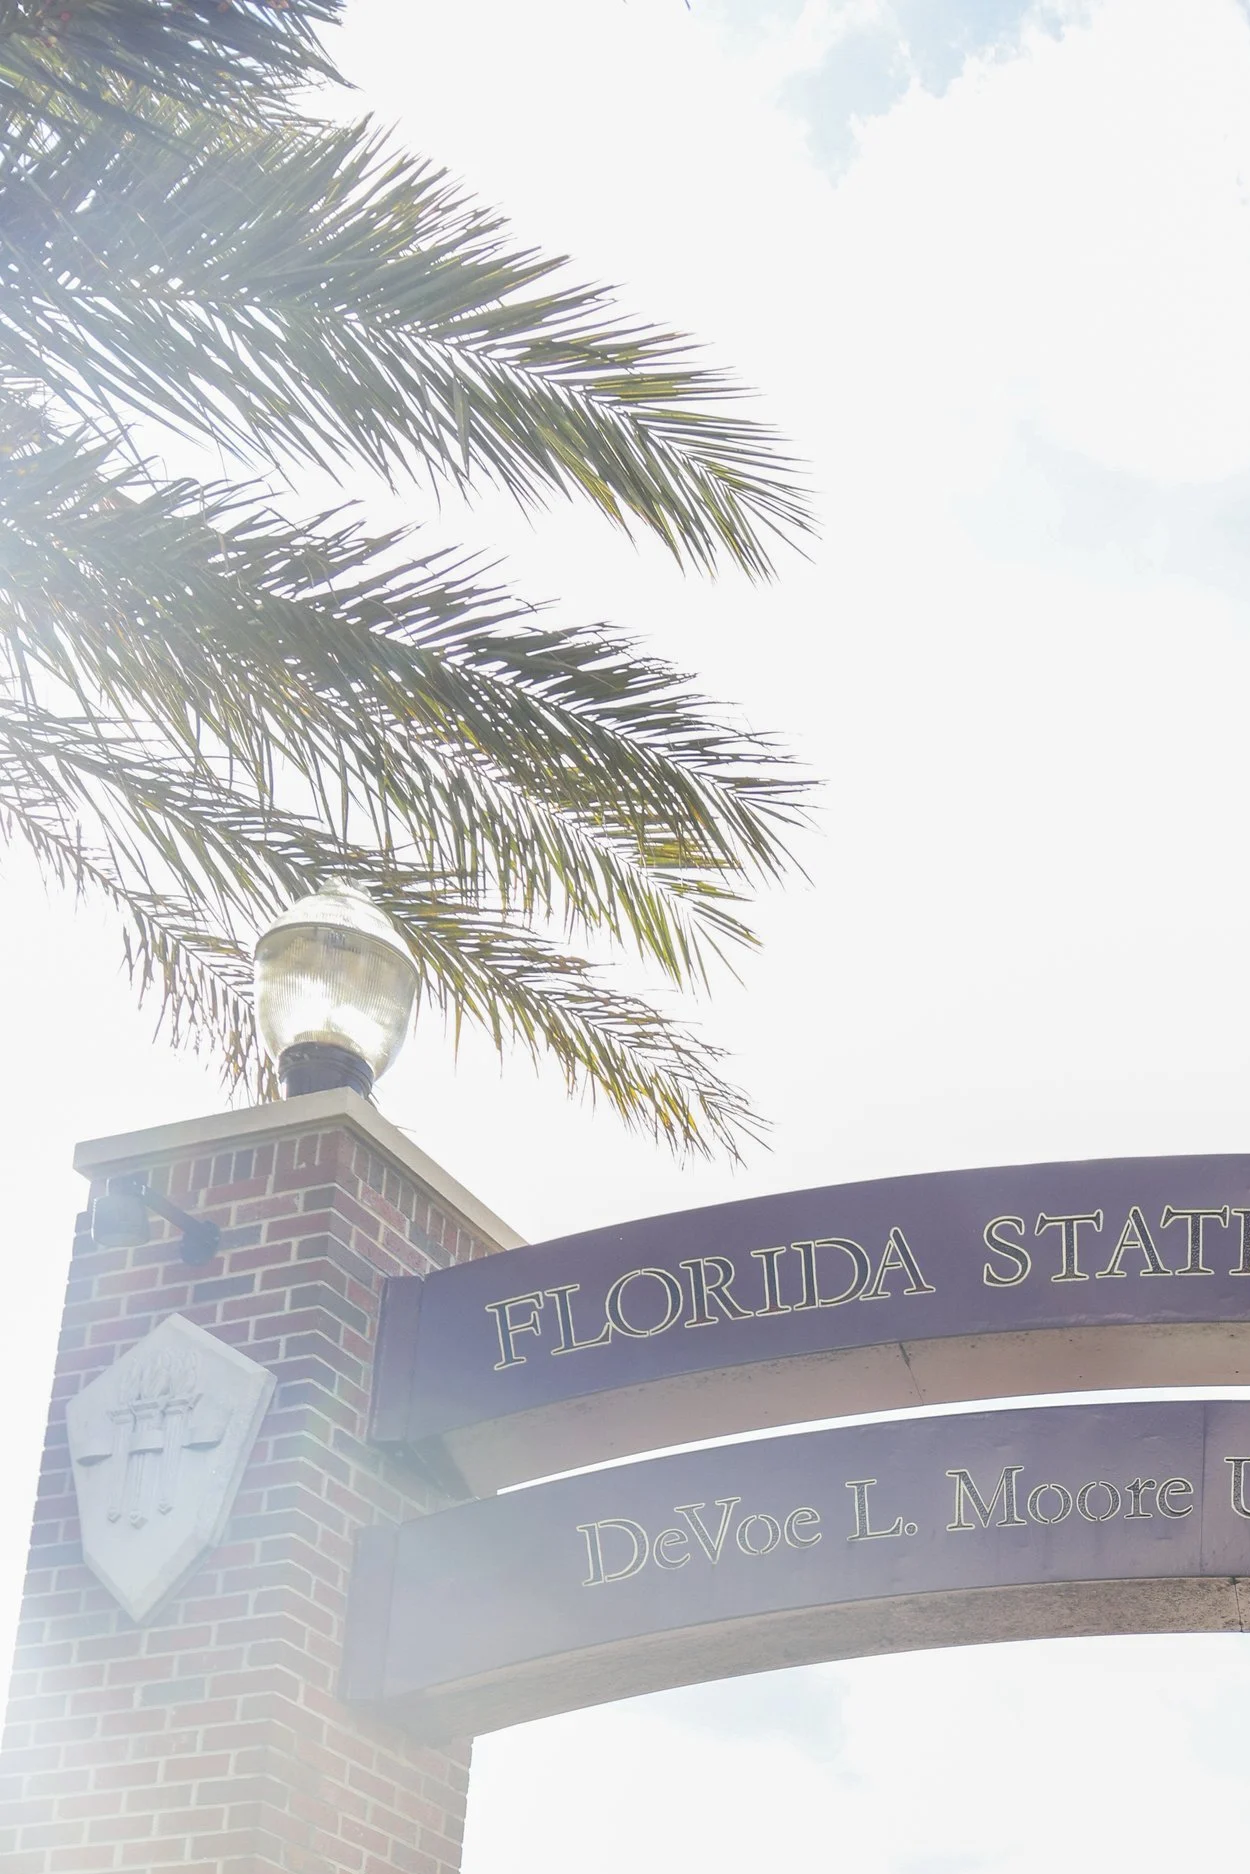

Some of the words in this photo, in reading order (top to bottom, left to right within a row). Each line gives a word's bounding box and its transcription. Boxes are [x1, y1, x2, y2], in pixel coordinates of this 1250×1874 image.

[485, 1227, 935, 1371] FLORIDA
[577, 1496, 823, 1586] DeVoe
[844, 1479, 918, 1543] L.
[946, 1466, 1194, 1531] Moore
